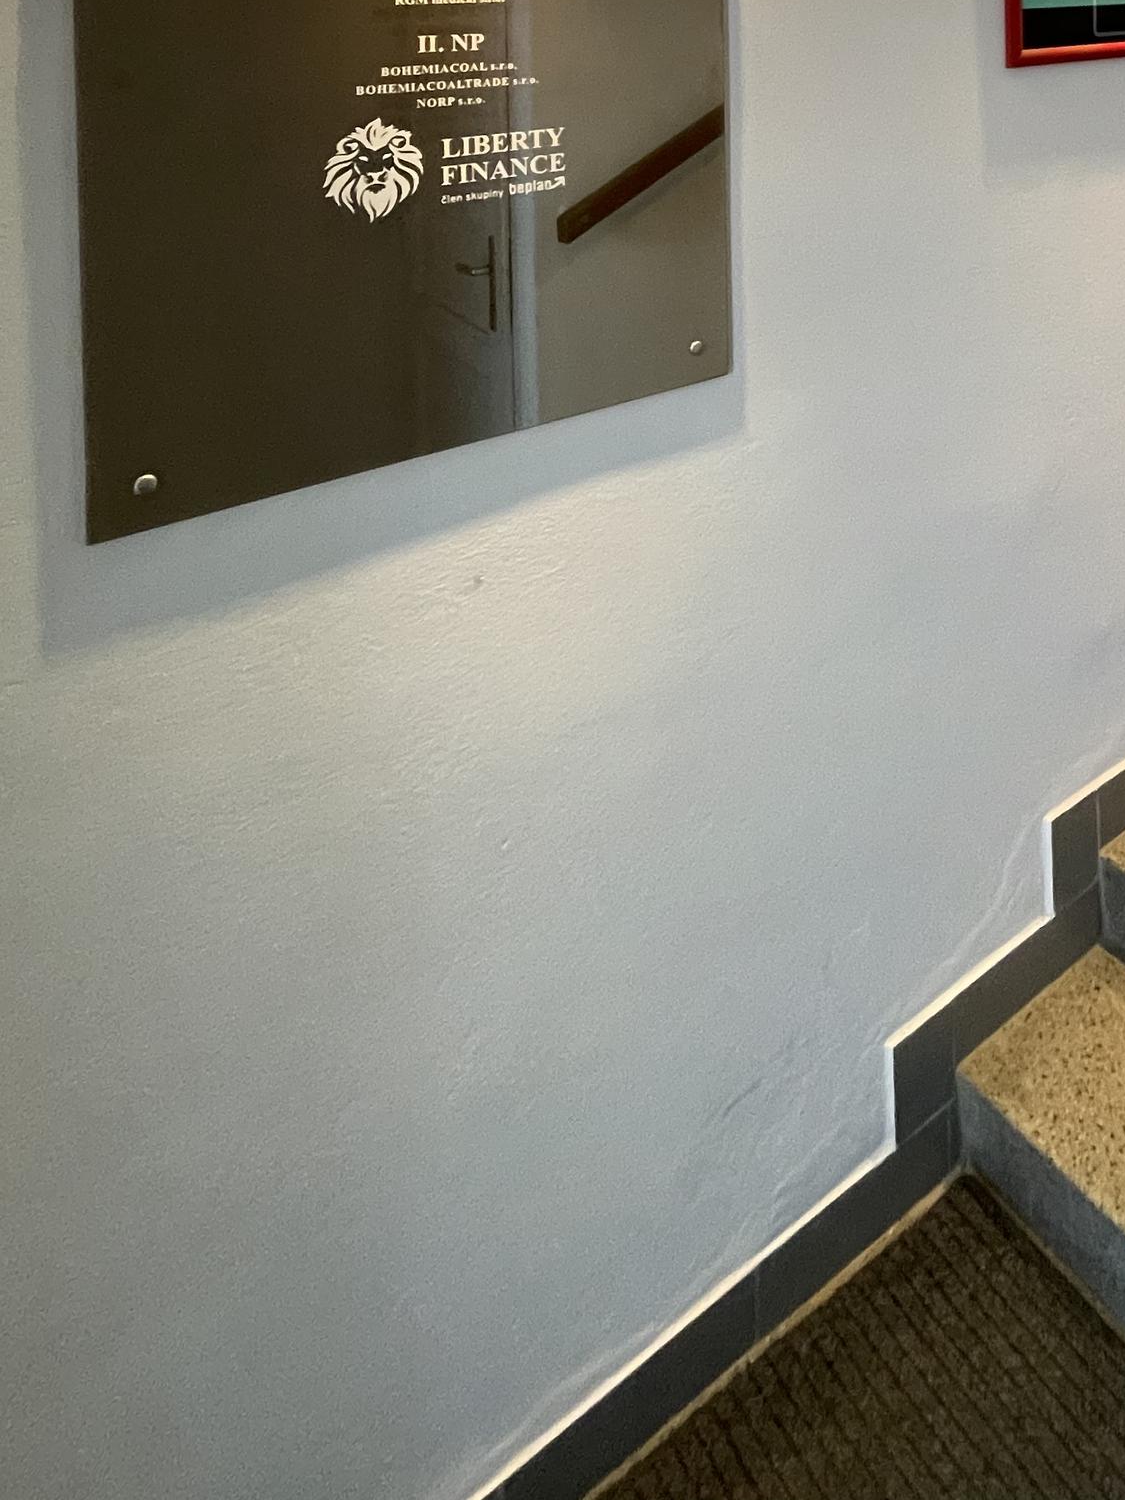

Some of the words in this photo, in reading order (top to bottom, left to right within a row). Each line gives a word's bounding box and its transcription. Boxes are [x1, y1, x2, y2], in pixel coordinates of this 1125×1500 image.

[417, 35, 444, 53] II.
[451, 33, 485, 52] NP
[381, 61, 488, 77] BOHEMIACOAL
[490, 62, 518, 71] s.r.o.
[355, 77, 509, 96] BOHEMIACOALTRADE
[513, 77, 539, 85] s.r.o.
[416, 97, 455, 109] NORP
[458, 97, 486, 106] s.r.o.
[441, 127, 565, 159] LIBERTY
[441, 153, 566, 186] FINANCE
[465, 189, 504, 201] skupiny
